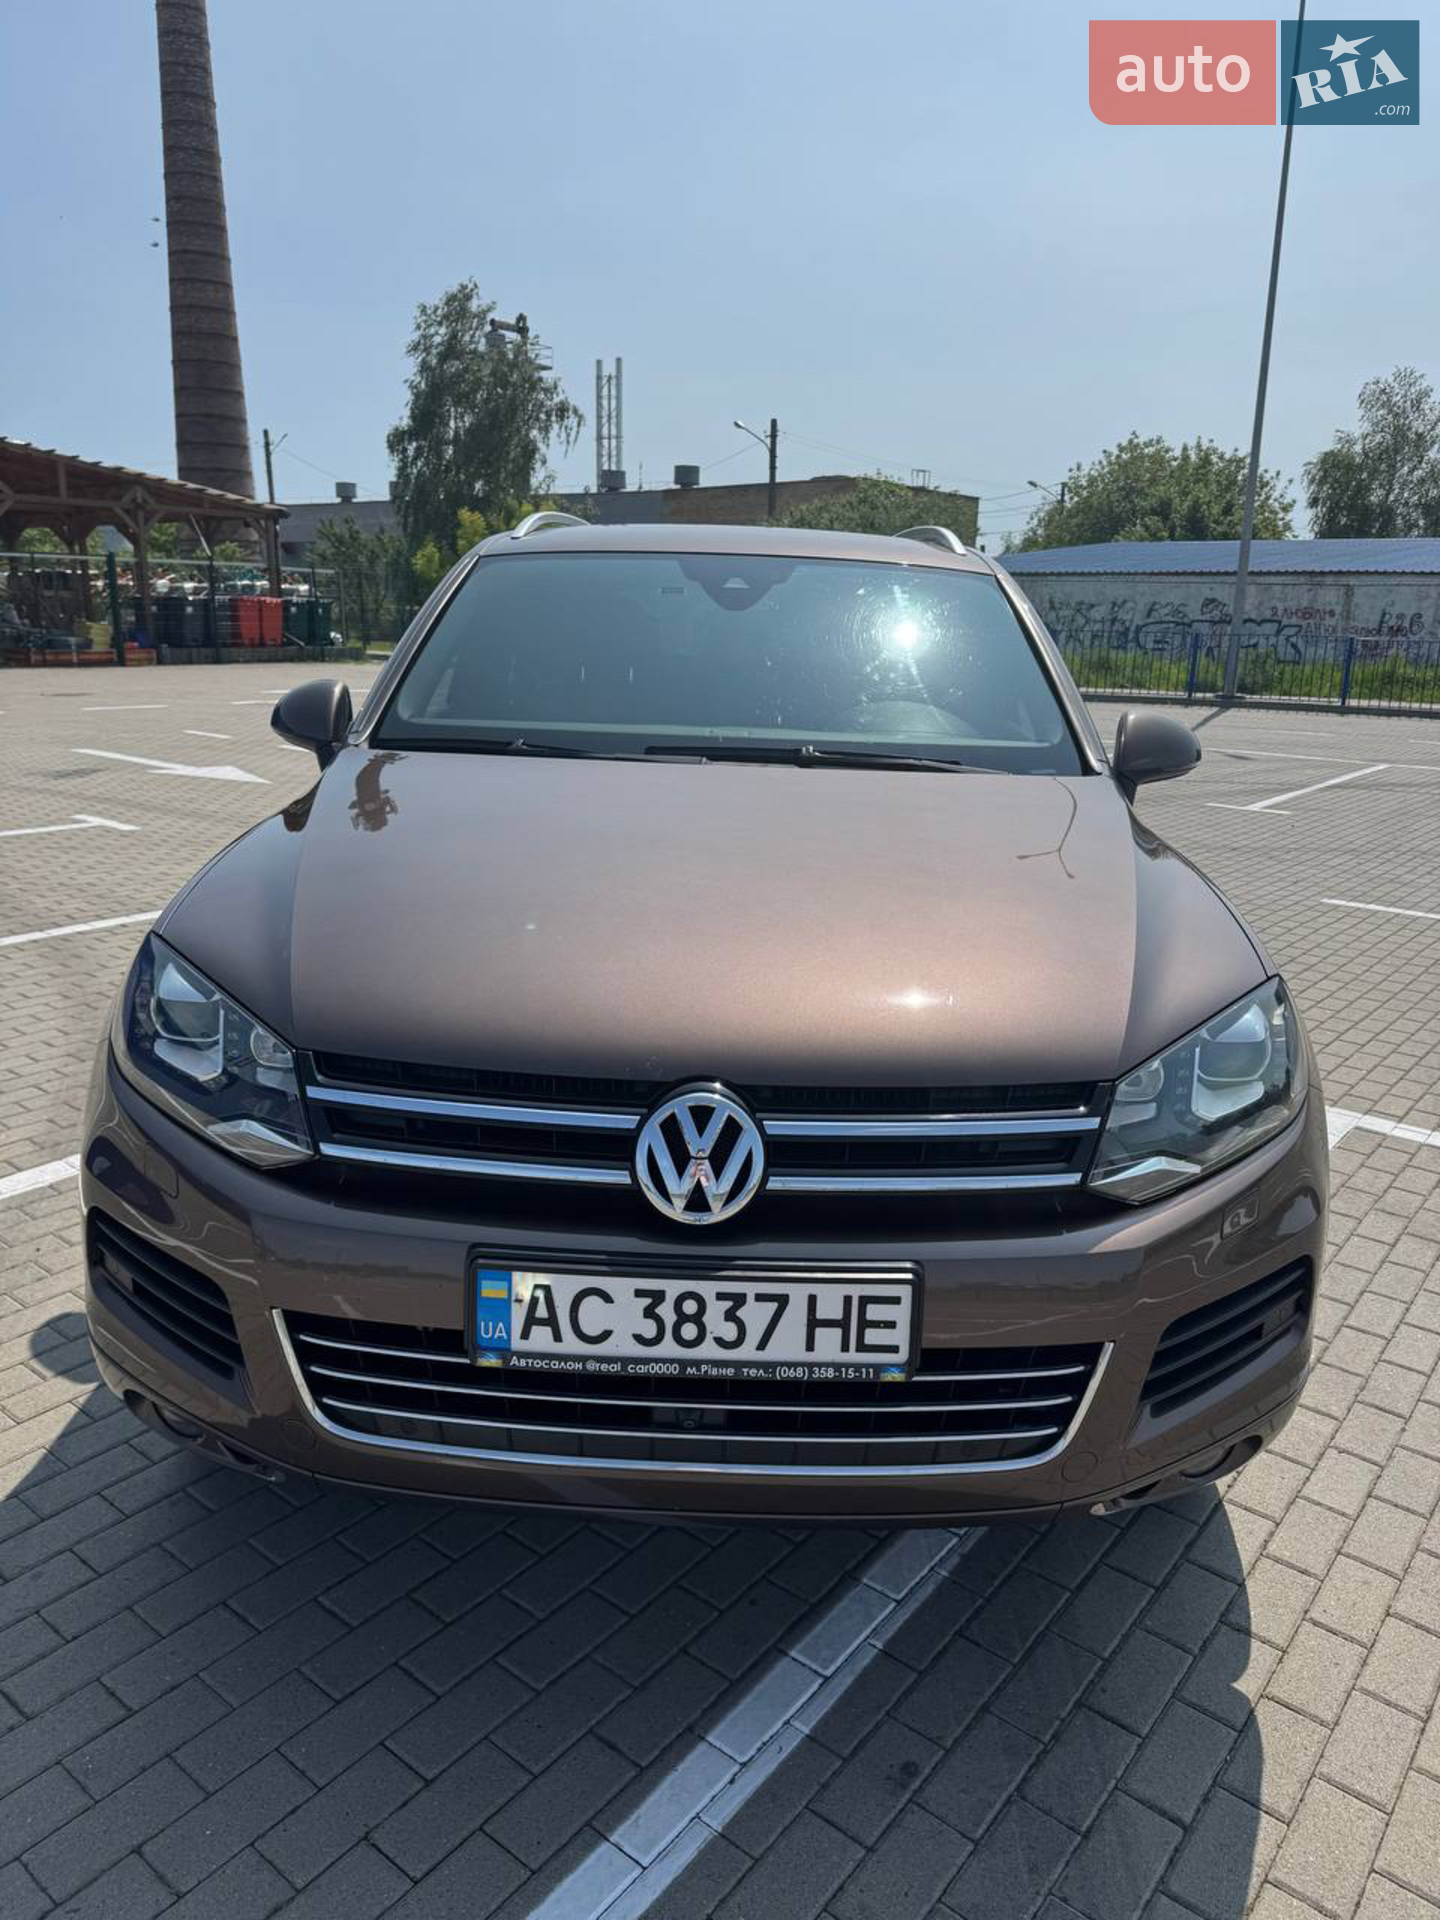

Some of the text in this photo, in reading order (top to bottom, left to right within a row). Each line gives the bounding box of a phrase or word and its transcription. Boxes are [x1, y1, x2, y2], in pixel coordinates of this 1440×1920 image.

[479, 1321, 508, 1341] UA
[519, 1283, 902, 1354] AC 3837 HE
[509, 1355, 583, 1371] Автосалон
[741, 1367, 773, 1378] тел.:
[775, 1366, 809, 1380] (068)
[812, 1367, 875, 1380] 358-15-11
